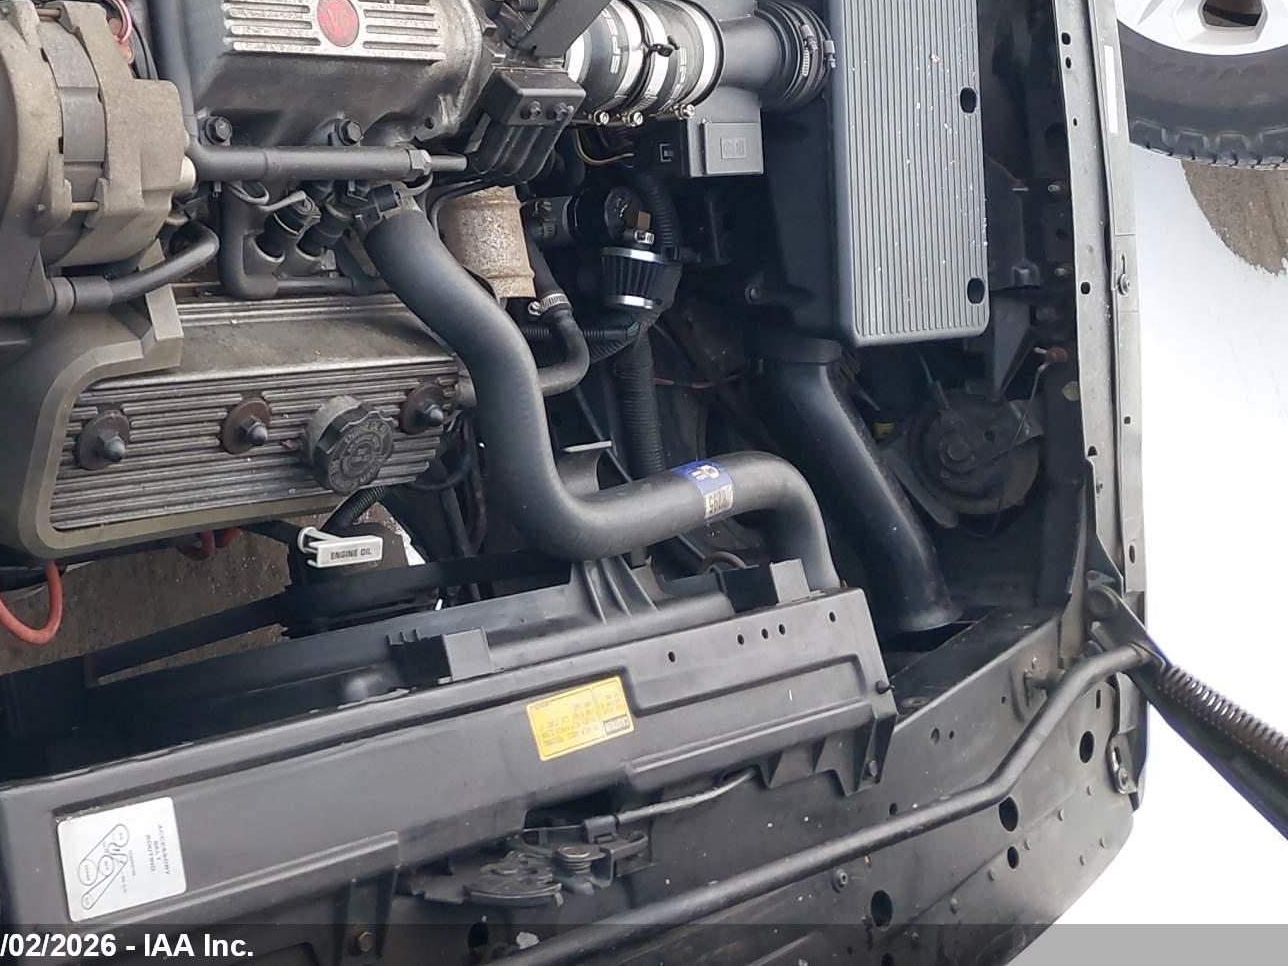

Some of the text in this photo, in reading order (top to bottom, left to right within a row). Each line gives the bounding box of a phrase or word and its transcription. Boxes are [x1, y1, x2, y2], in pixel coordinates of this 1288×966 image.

[330, 547, 372, 560] ENGINE OIL
[145, 834, 156, 872] ROUTING
[152, 840, 162, 861] BELT
[158, 824, 171, 875] ACCESSORY
